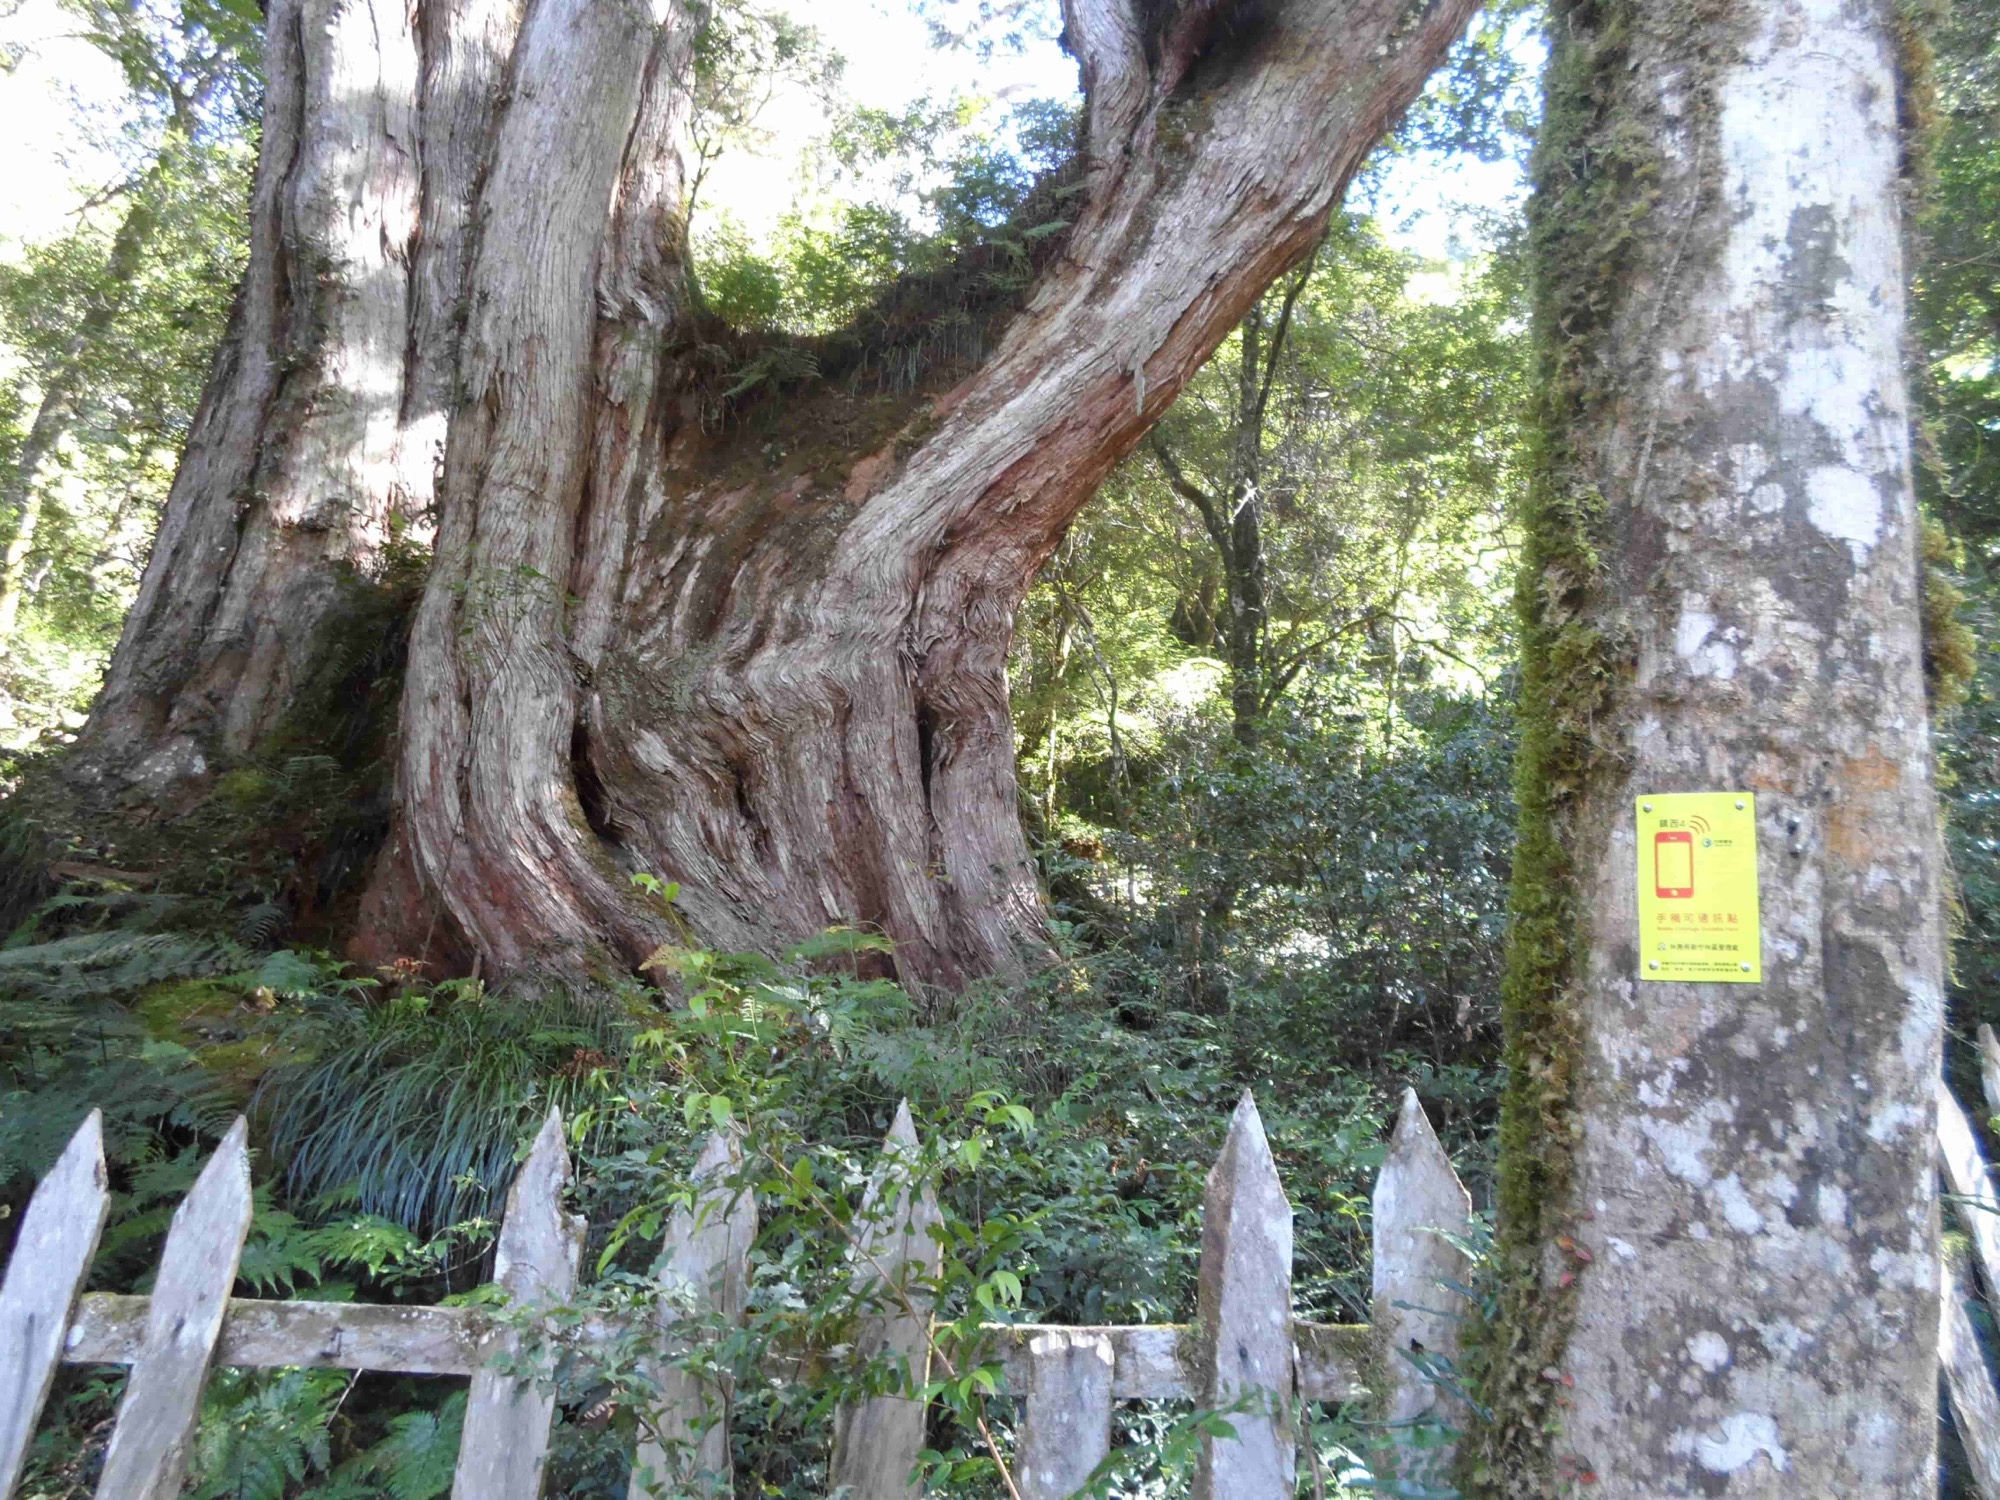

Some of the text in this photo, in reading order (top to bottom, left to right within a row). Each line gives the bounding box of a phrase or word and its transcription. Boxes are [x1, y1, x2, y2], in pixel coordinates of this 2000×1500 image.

[1656, 913, 1738, 924] 手機可通訊點
